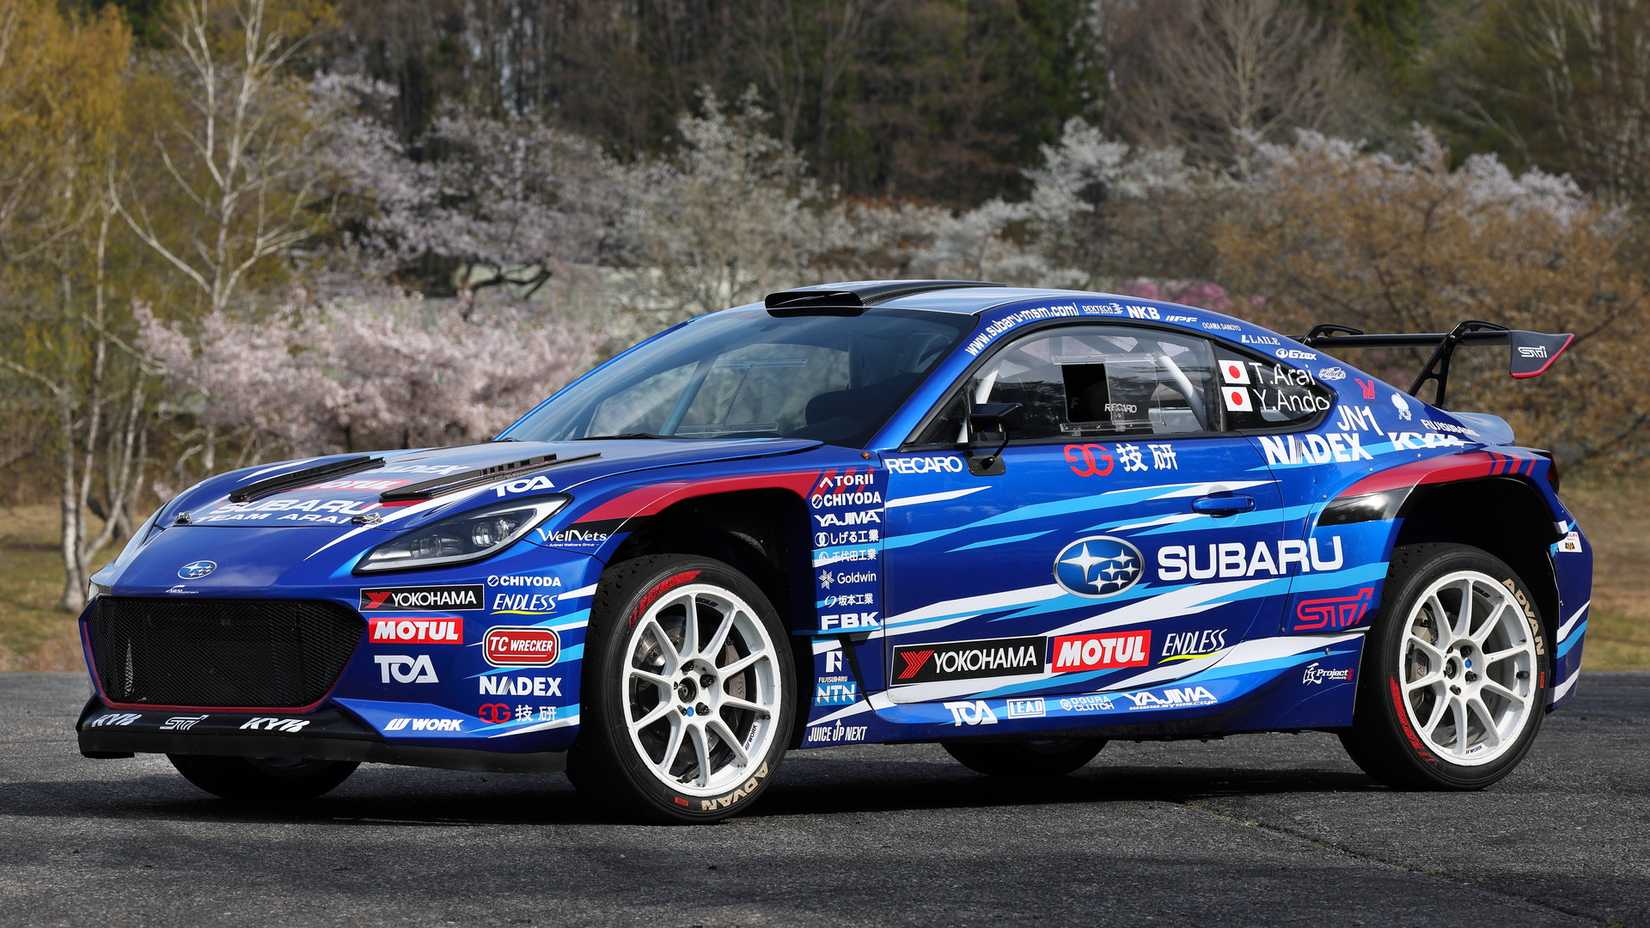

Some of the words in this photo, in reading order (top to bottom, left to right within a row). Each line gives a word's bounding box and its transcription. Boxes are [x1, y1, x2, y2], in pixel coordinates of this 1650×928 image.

[1126, 305, 1160, 320] NKB
[965, 302, 1079, 357] www.subaru-msm.com/
[1249, 362, 1316, 386] T.Arai
[1253, 389, 1330, 412] Y.Ando
[1337, 405, 1384, 436] JN1
[1116, 443, 1178, 472] 技研
[1258, 432, 1374, 465] NADEX
[885, 456, 963, 474] RECARO
[490, 475, 554, 497] TOA
[835, 474, 873, 486] TORII
[208, 499, 382, 515] SUBARU
[824, 491, 882, 507] CHIYODA
[196, 513, 273, 523] TEAM
[277, 513, 353, 524] ARAI
[814, 511, 881, 527] YAJIMA
[536, 528, 607, 542] WellNets
[830, 529, 879, 545] しげる工業
[1157, 535, 1344, 581] SUBARU
[500, 576, 561, 587] CHIYODA
[837, 571, 877, 584] Goldwin
[391, 590, 477, 606] YOKOHAMA
[492, 593, 560, 611] ENDLESS
[838, 593, 874, 606] 坂本工業
[821, 612, 880, 630] FBK
[1503, 579, 1545, 655] ADVAN
[374, 621, 459, 641] MOTUL
[490, 636, 509, 652] TC
[510, 639, 553, 652] WRECKER
[1162, 628, 1230, 657] ENDLESS
[934, 645, 1038, 673] YOKOHAMA
[1056, 636, 1146, 668] MOTUL
[374, 655, 439, 684] TOA
[479, 676, 562, 697] NADEX
[817, 684, 855, 704] NTN
[1121, 686, 1216, 707] YAJIMA
[515, 704, 557, 722] 技研
[943, 700, 998, 726] TOA
[1010, 700, 1043, 715] LEAD
[92, 713, 142, 729] KYB
[239, 717, 311, 733] KYB
[412, 718, 464, 731] WORK
[808, 726, 832, 742] JUICE
[832, 722, 845, 742] UP
[845, 726, 868, 741] NEXT
[702, 760, 769, 811] ADVAN
